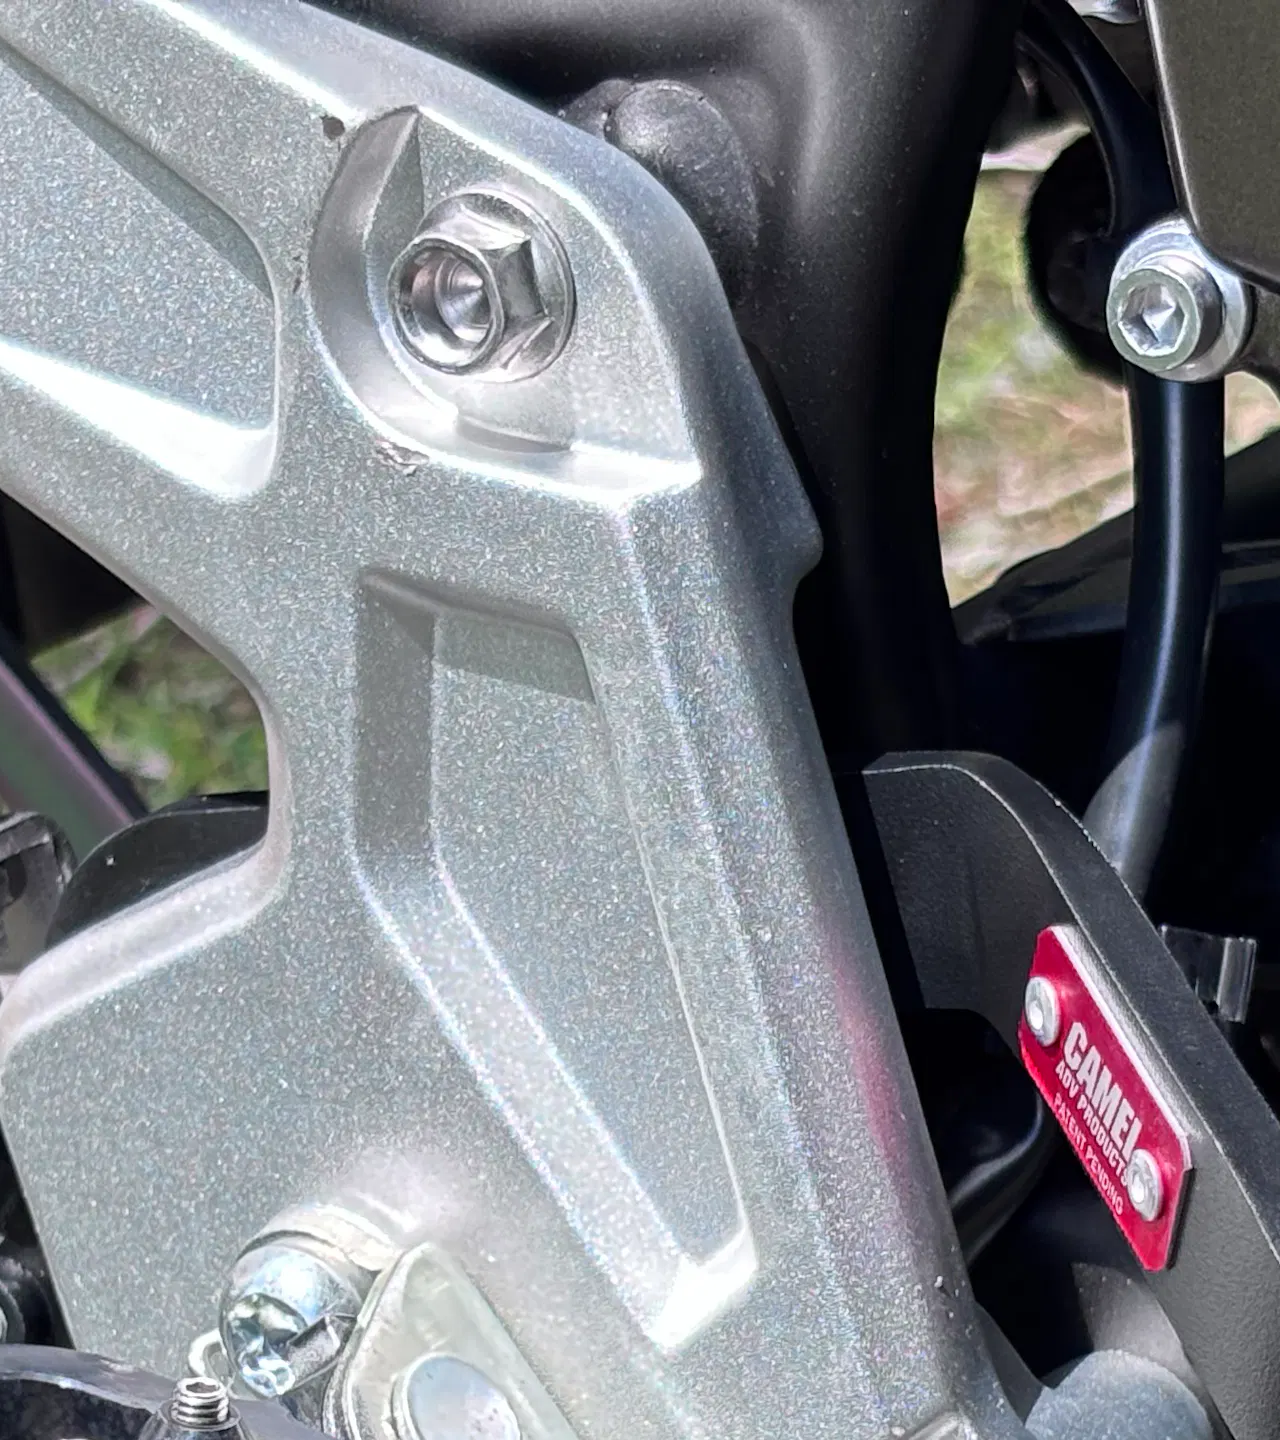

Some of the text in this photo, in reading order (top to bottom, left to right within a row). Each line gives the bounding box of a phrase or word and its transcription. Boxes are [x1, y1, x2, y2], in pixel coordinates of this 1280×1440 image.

[1053, 1092, 1124, 1216] PATENT PENDING
[1055, 1058, 1128, 1187] ADV PRODUCTS
[1064, 1021, 1143, 1164] CAMEL
